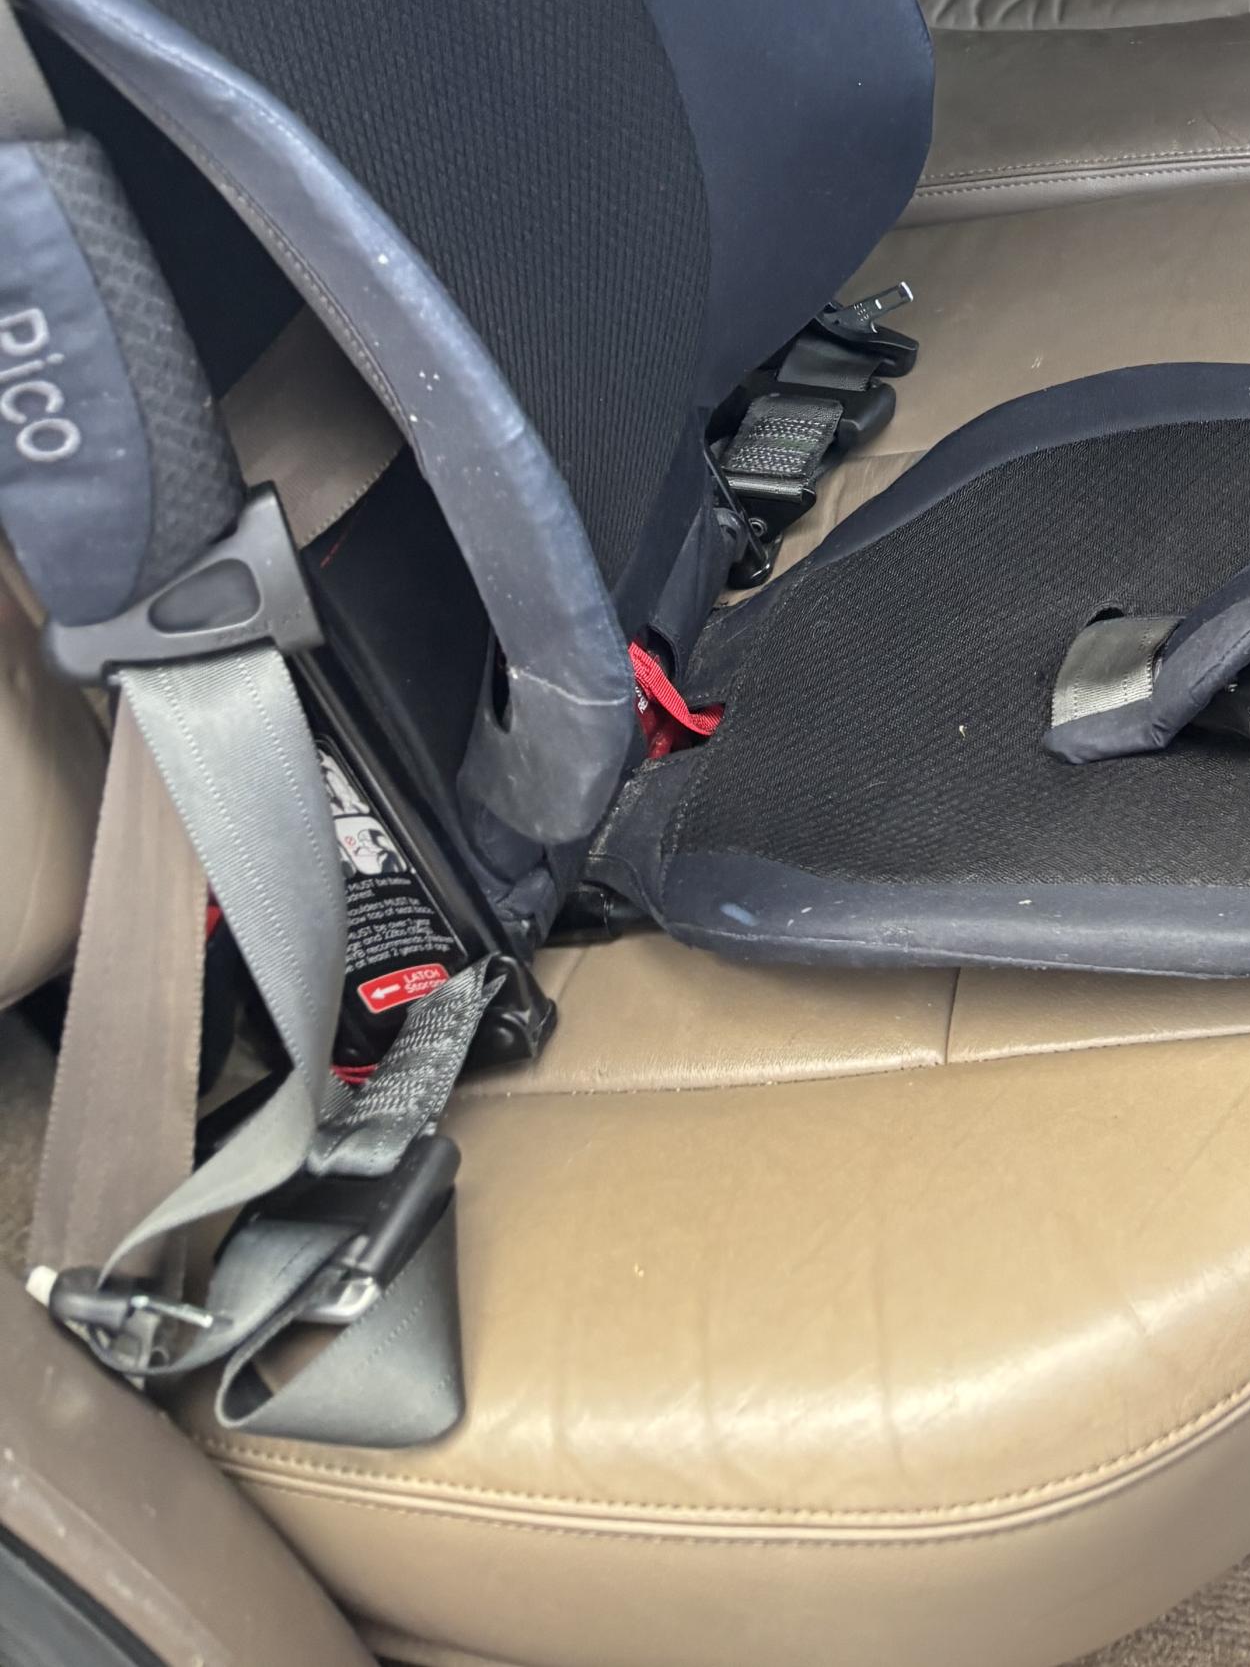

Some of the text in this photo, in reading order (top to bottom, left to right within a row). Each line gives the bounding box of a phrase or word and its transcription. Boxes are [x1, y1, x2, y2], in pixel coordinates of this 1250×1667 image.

[348, 878, 374, 891] MUST
[347, 901, 384, 917] oulders
[403, 969, 441, 984] LATCH
